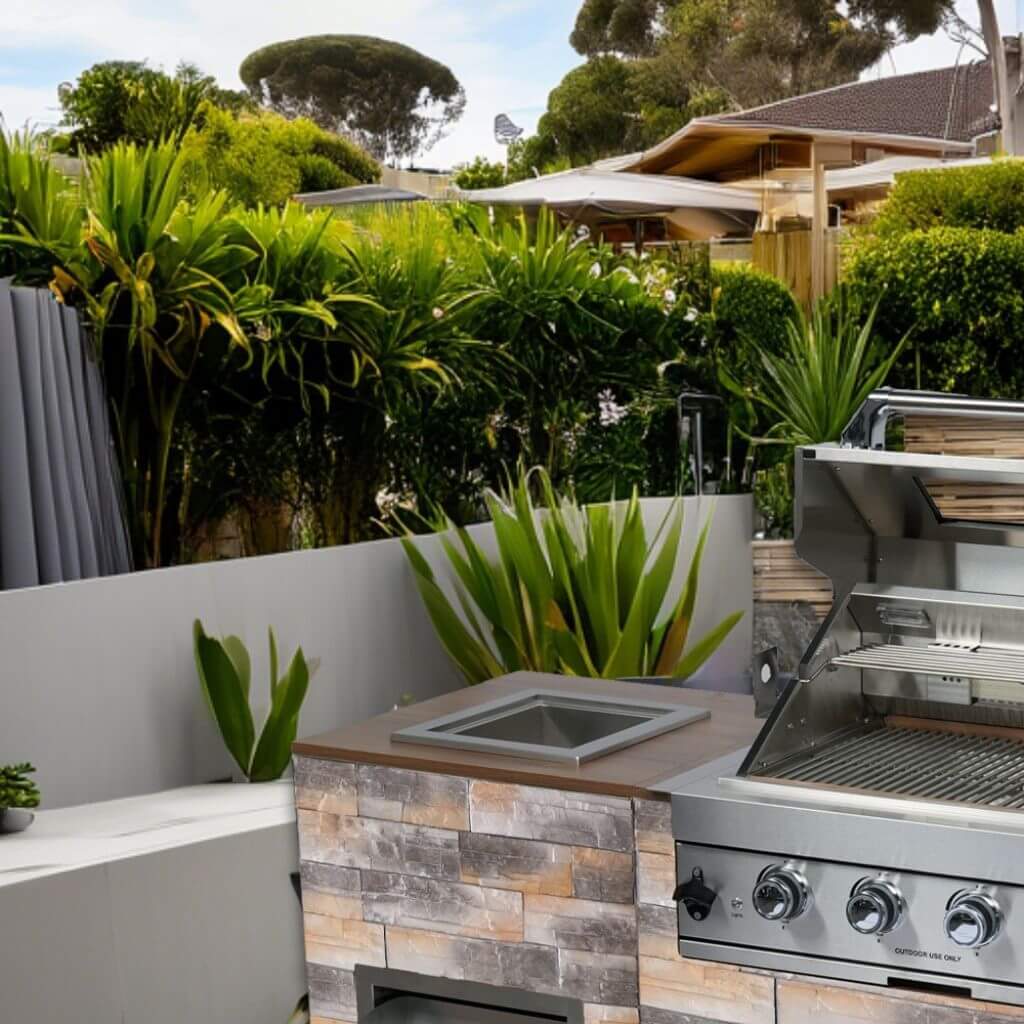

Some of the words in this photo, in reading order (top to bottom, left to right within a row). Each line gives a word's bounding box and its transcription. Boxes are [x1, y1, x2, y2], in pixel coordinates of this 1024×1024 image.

[894, 947, 927, 958] OUTDOOR
[928, 951, 942, 960] USE
[943, 954, 962, 963] ONLY
